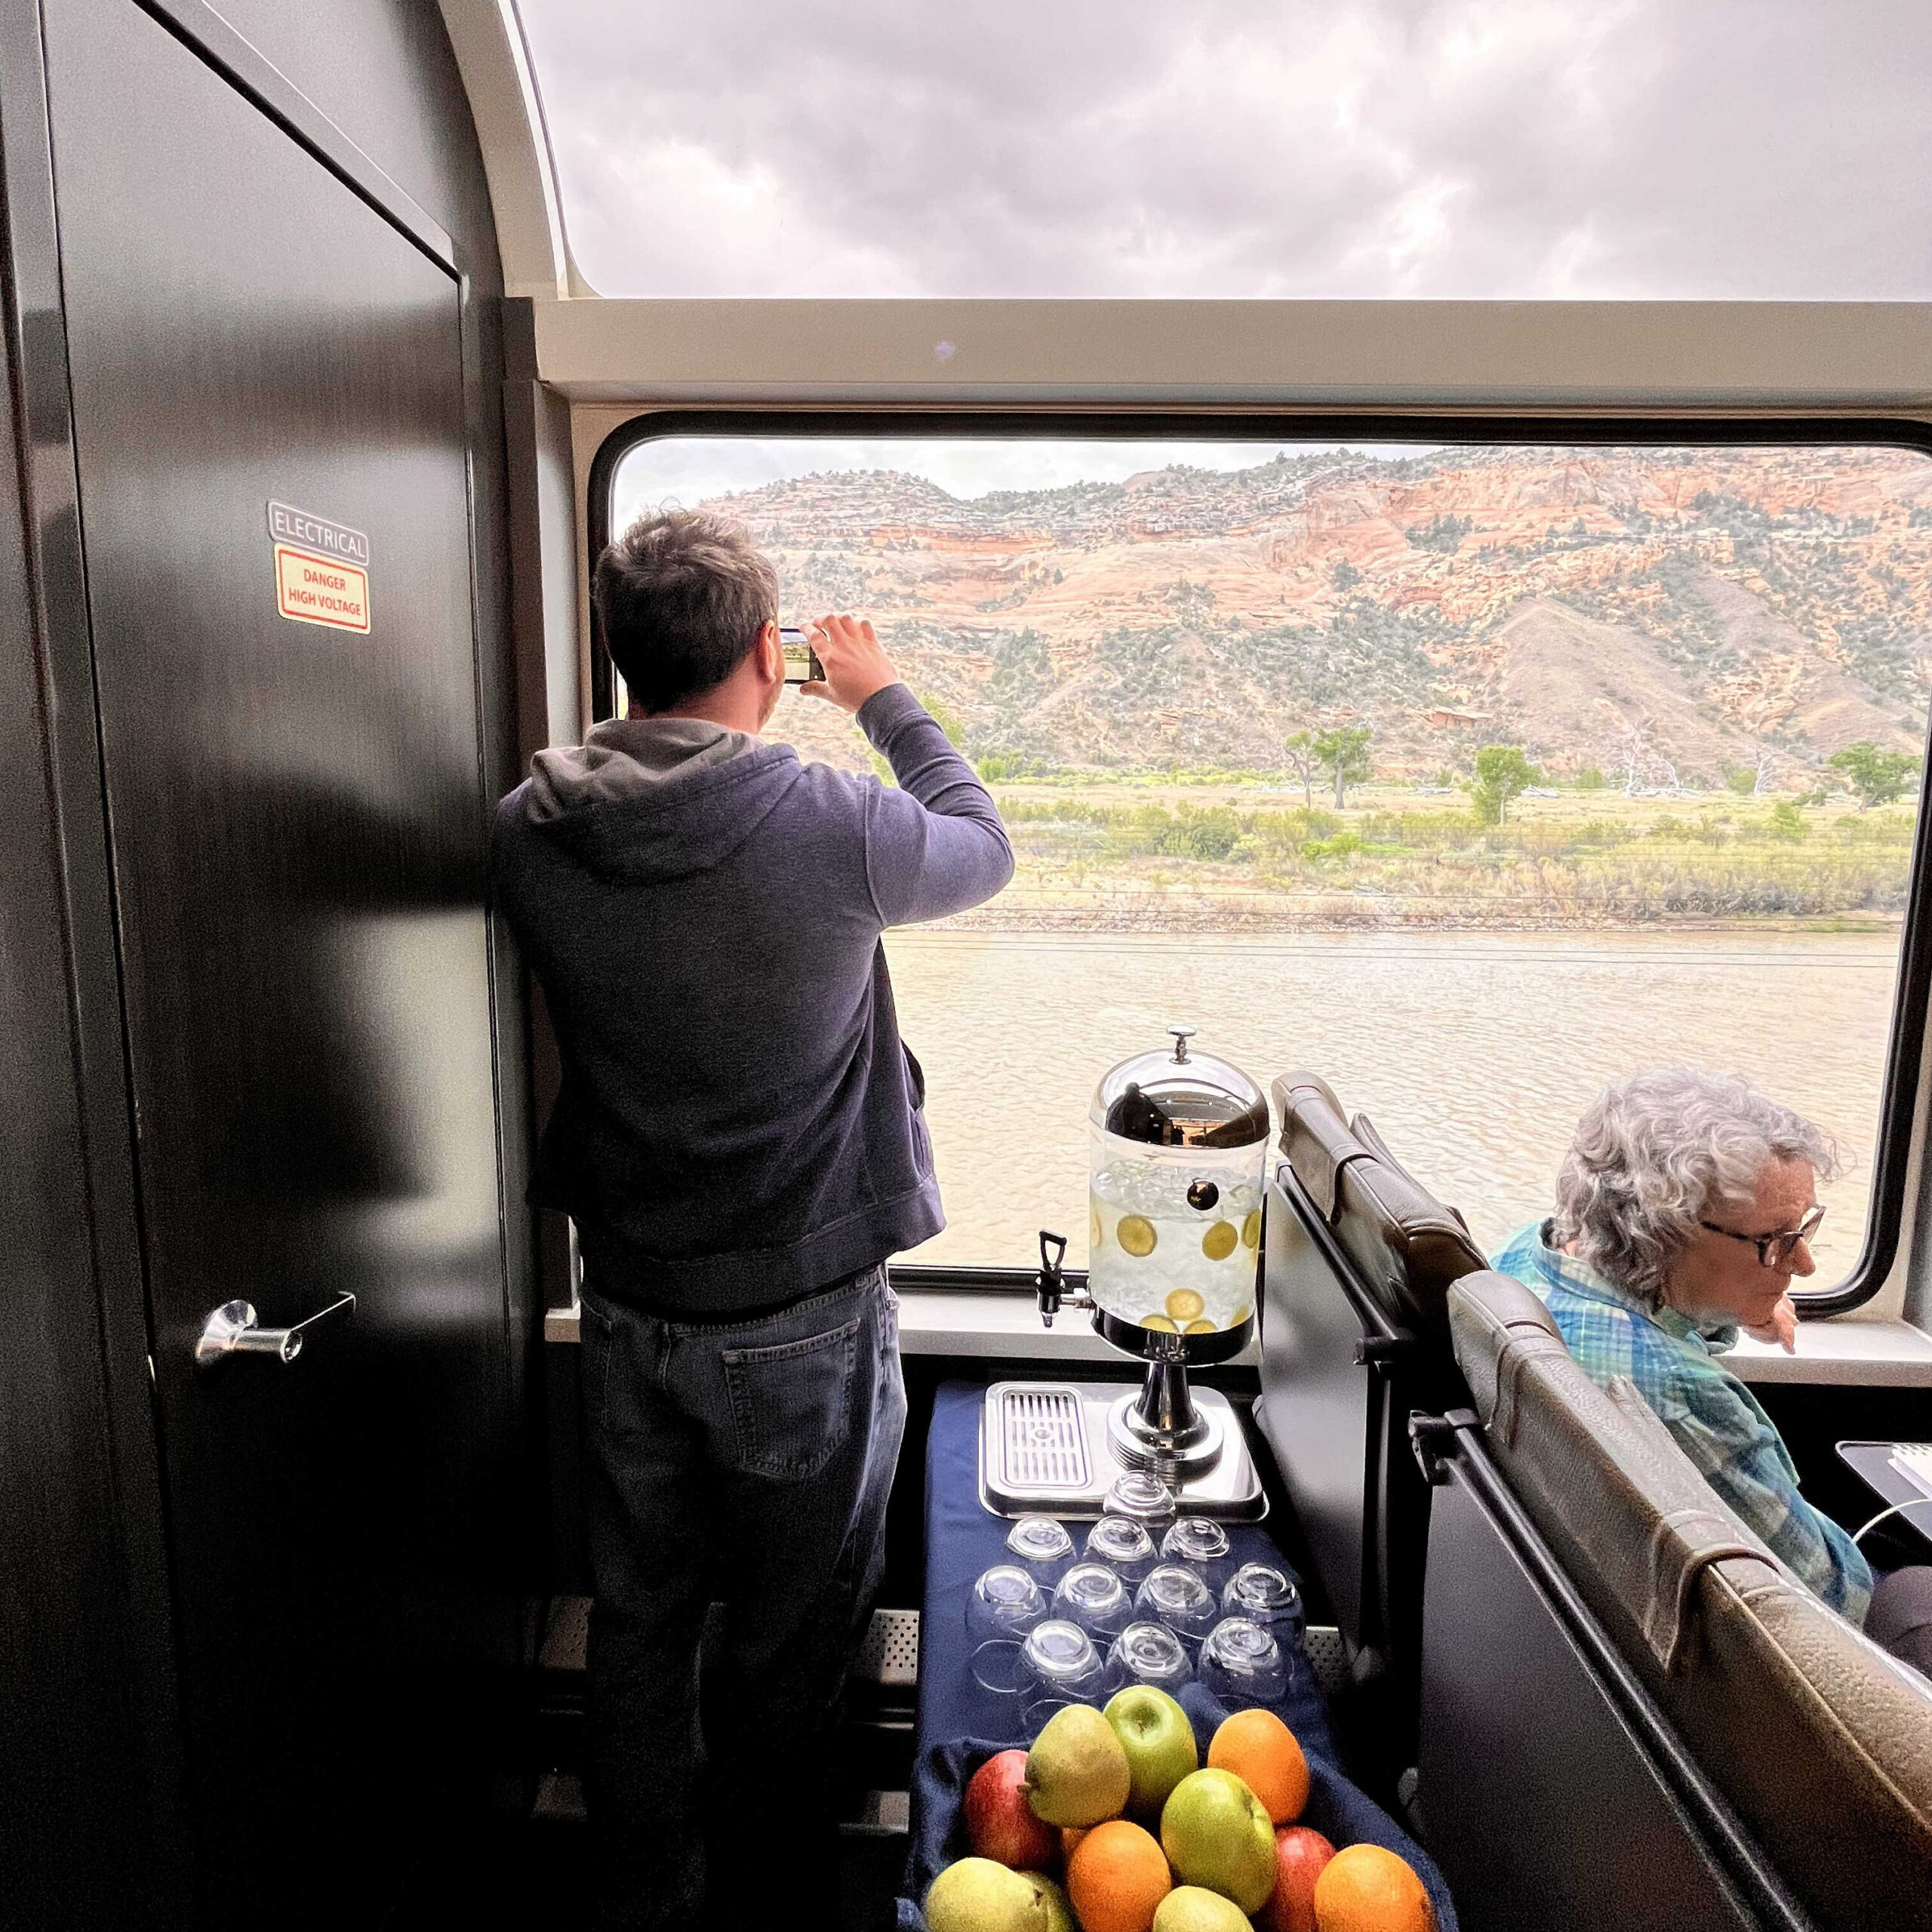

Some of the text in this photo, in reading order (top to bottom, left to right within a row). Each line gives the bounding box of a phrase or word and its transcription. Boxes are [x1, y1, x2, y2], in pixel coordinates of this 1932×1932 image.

[275, 511, 365, 558] ELECTRICAL
[303, 569, 346, 592] DANGER
[288, 587, 361, 616] HIGH VOLTAGE
